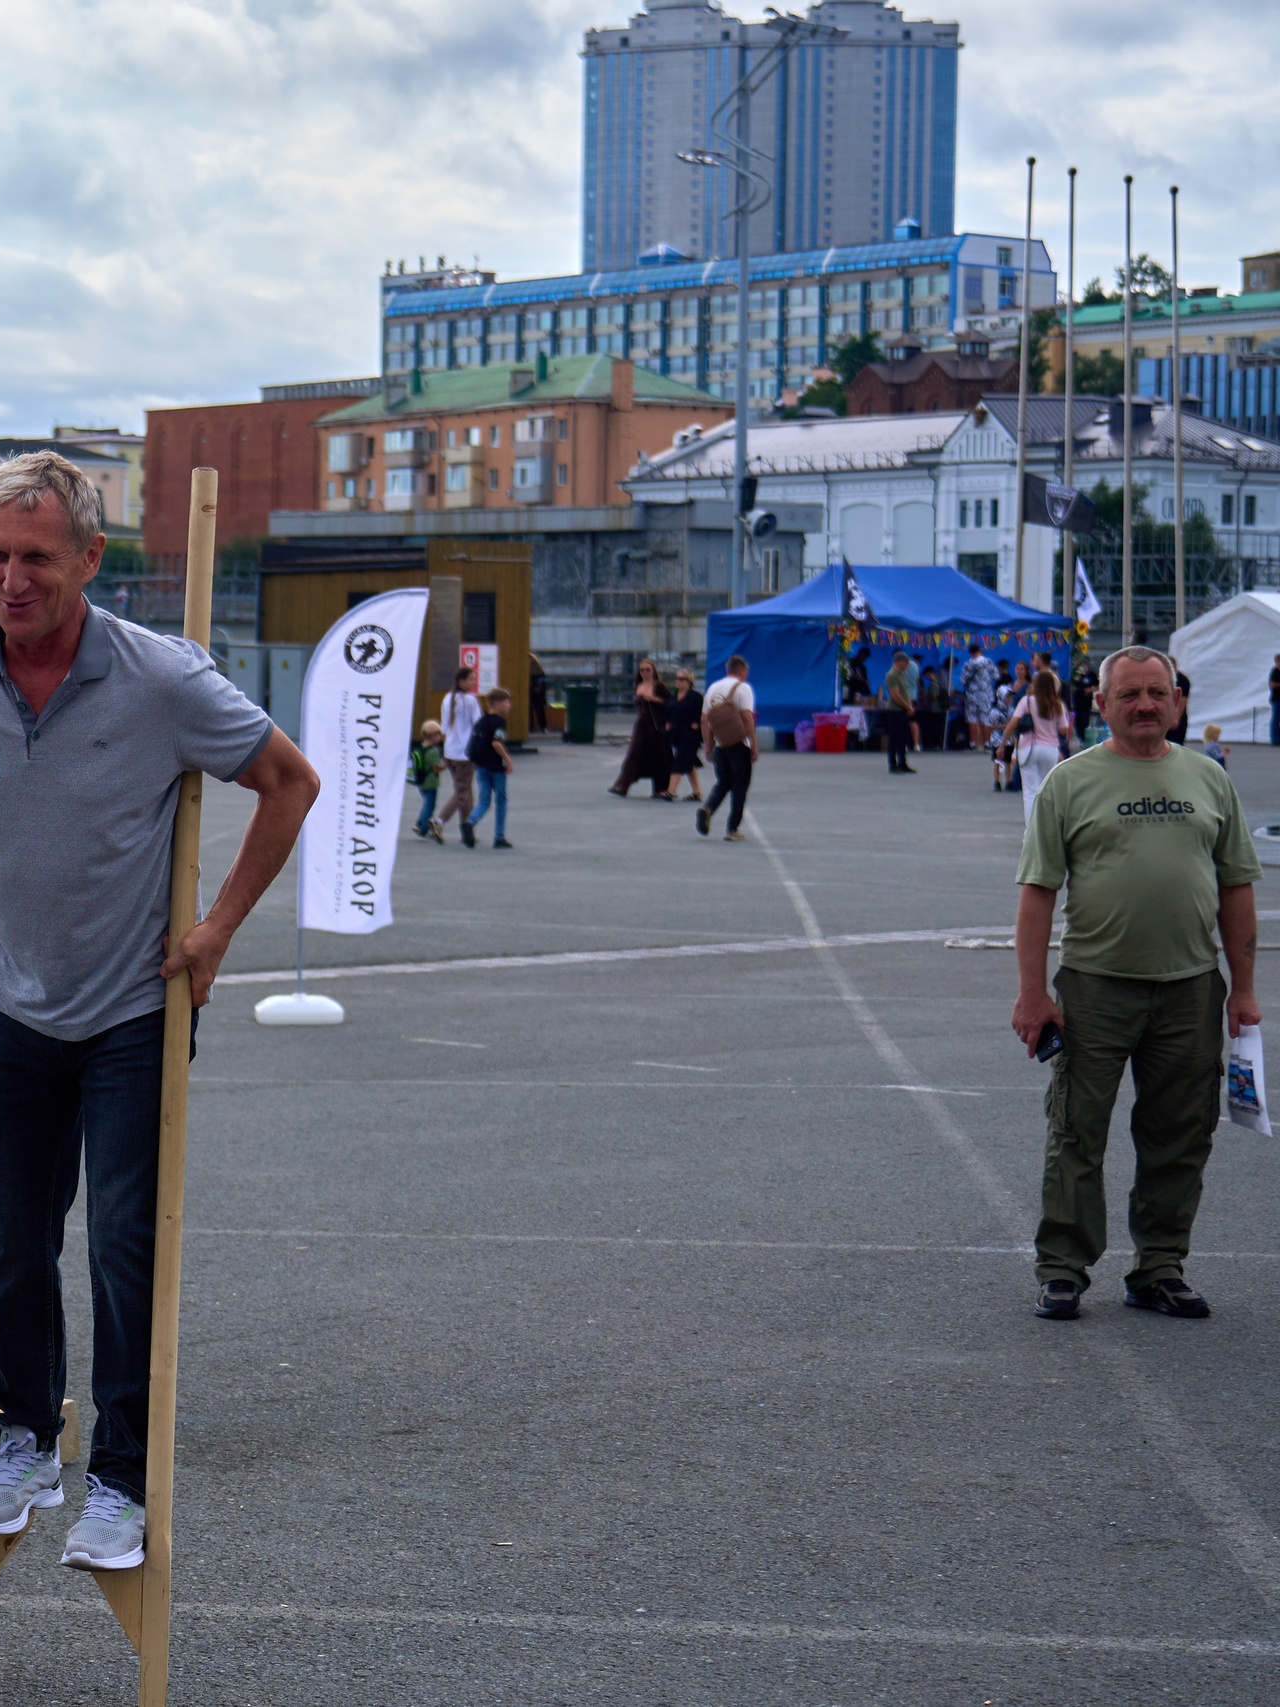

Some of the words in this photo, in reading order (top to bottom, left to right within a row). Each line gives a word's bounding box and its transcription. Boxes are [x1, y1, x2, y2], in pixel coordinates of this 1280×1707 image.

[355, 693, 382, 828] РУССКИЙ
[1116, 796, 1196, 817] adidas
[1117, 815, 1188, 825] SPORTSWEAR
[349, 836, 377, 916] ДВОР
